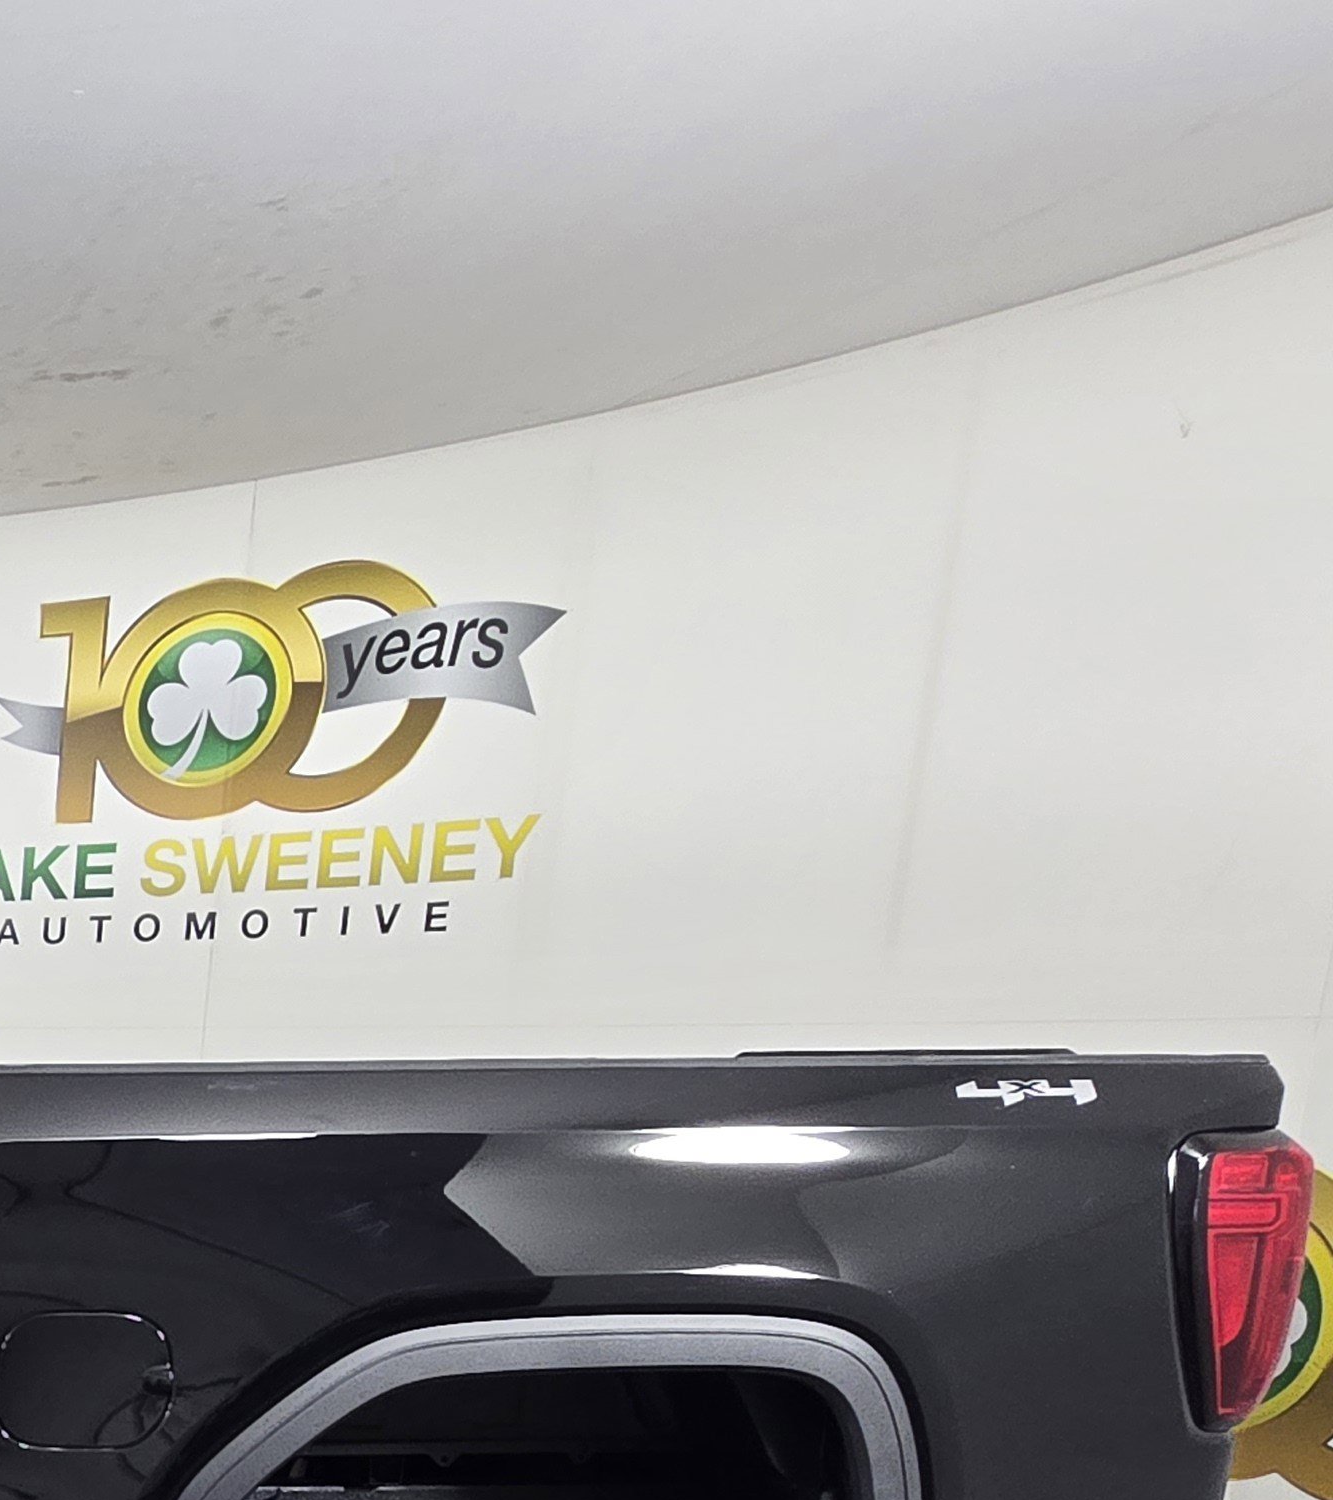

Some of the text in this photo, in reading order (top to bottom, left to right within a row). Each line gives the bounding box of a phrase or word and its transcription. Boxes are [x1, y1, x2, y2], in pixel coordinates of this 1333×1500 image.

[39, 559, 446, 824] 100
[335, 616, 510, 700] years
[140, 813, 542, 897] SWEENEY
